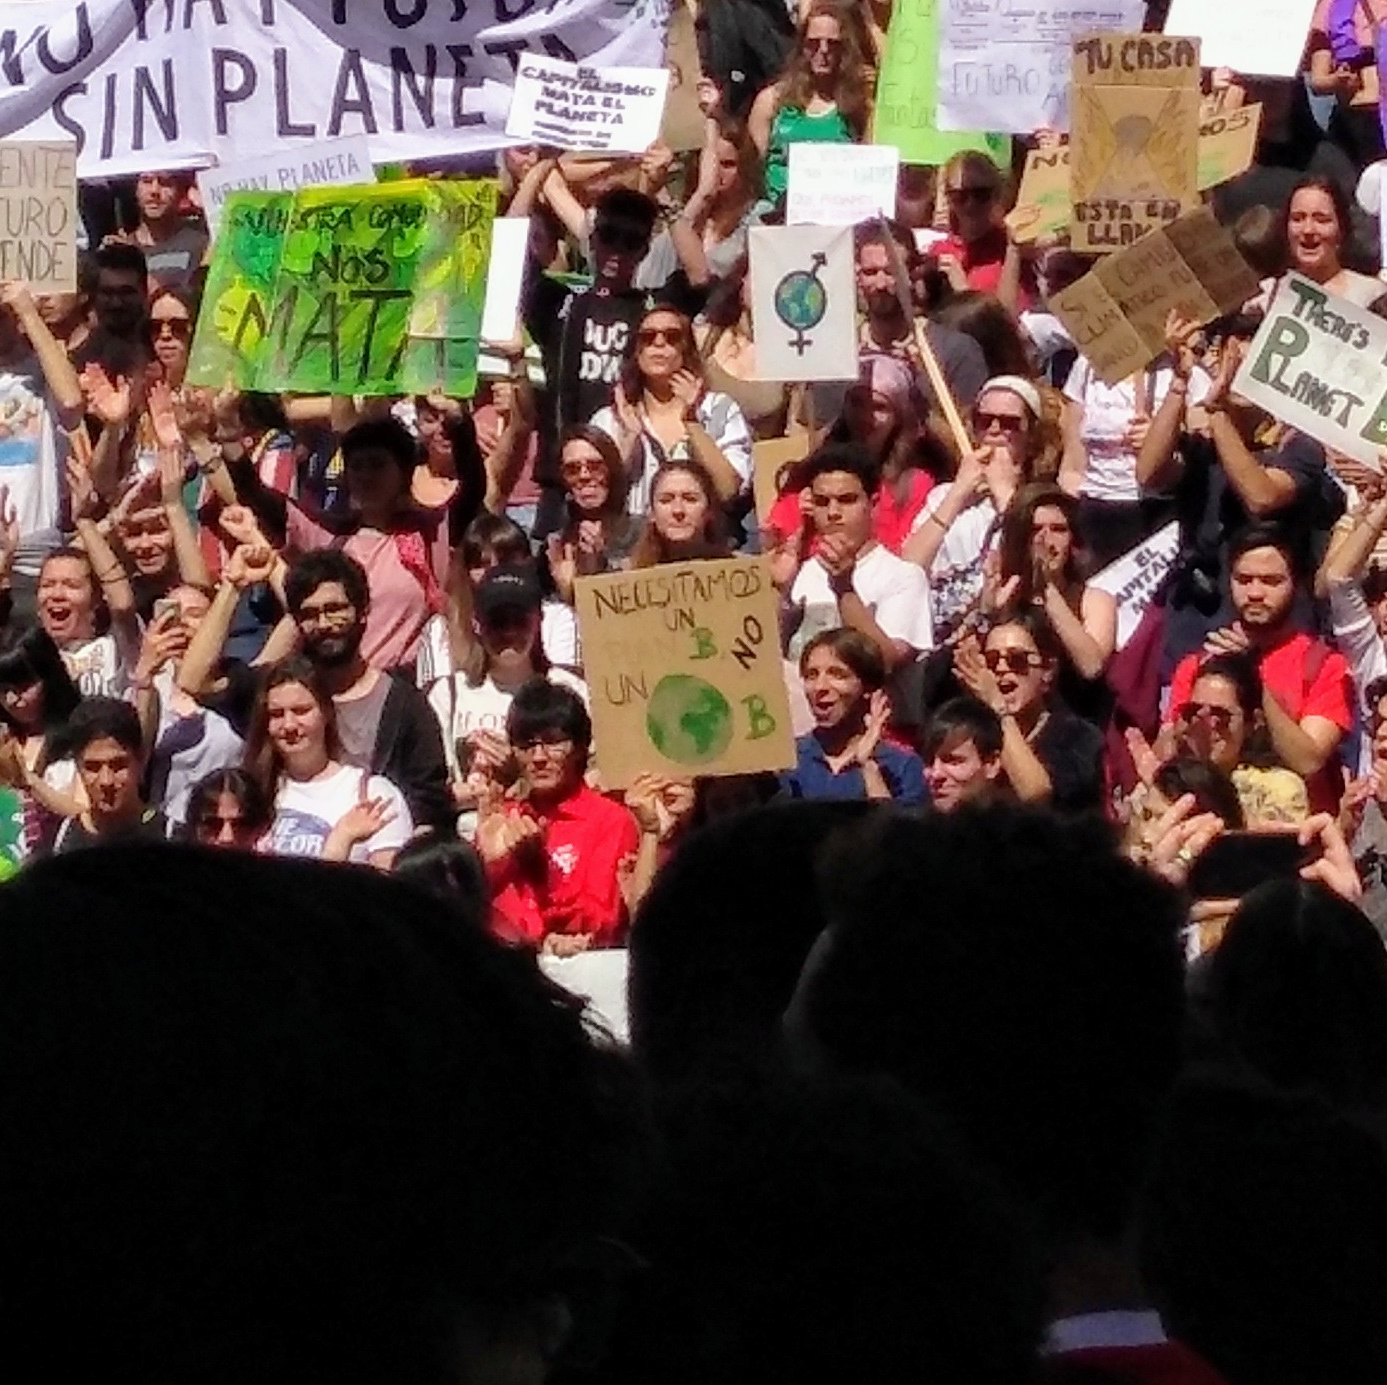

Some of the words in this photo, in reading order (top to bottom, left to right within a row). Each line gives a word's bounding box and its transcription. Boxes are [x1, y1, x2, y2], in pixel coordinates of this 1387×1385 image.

[951, 60, 1041, 98] FUTURO
[1075, 37, 1112, 75] TU
[1120, 38, 1196, 72] CASA
[51, 56, 181, 161] SIN
[212, 33, 580, 137] PLANET
[521, 66, 657, 97] CAPITALISMO
[540, 85, 597, 106] MATA
[601, 96, 626, 110] EL
[534, 100, 624, 125] PLANETA
[209, 182, 234, 204] NO
[277, 152, 361, 188] PLANETA
[312, 245, 391, 285] NOS
[232, 285, 447, 385] MATA
[1290, 279, 1371, 351] THERE'S
[1249, 315, 1366, 429] PLANET
[1133, 546, 1161, 568] EL
[592, 564, 762, 621] NECESITAMOS
[665, 606, 696, 632] UN
[731, 614, 765, 670] NO
[604, 670, 649, 706] UN
[740, 693, 778, 741] B
